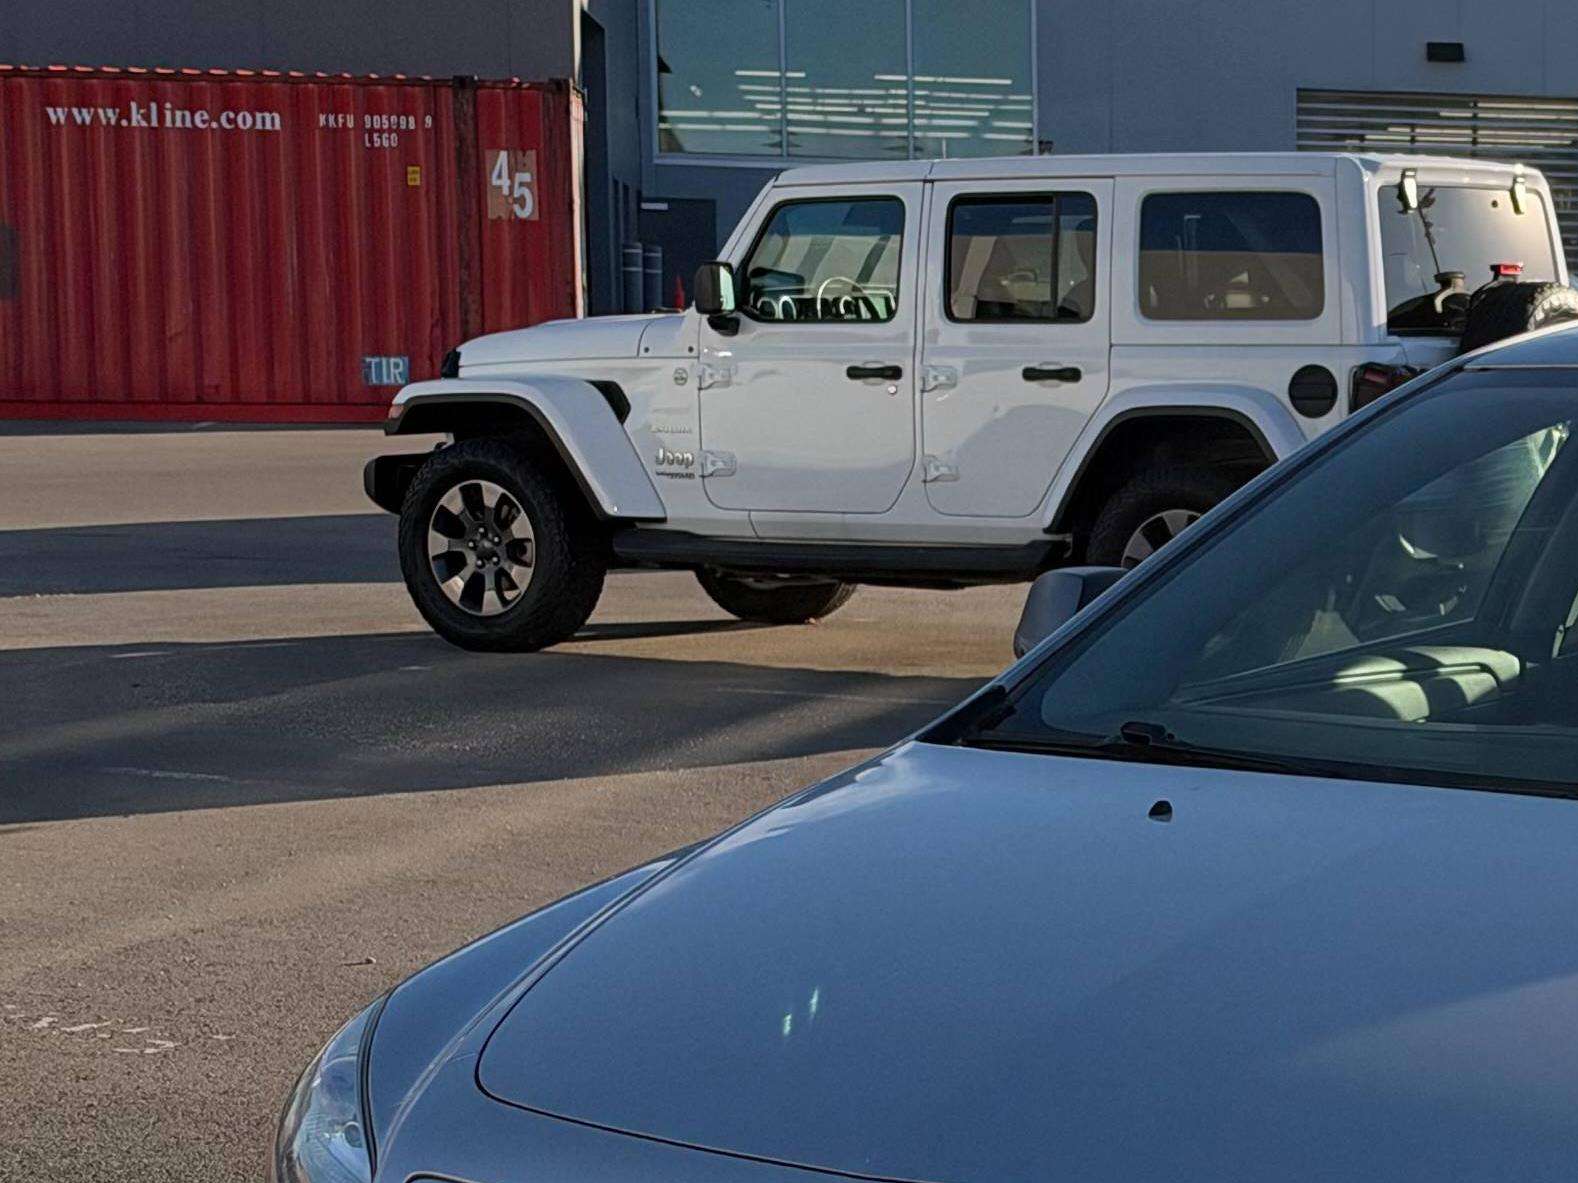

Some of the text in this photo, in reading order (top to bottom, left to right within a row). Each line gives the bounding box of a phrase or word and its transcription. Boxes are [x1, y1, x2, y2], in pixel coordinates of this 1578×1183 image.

[46, 101, 281, 130] www.kline.com
[319, 113, 354, 128] KKFU
[424, 115, 432, 128] 9
[492, 150, 533, 218] 45
[365, 357, 406, 384] TIR
[656, 448, 694, 468] Jeep
